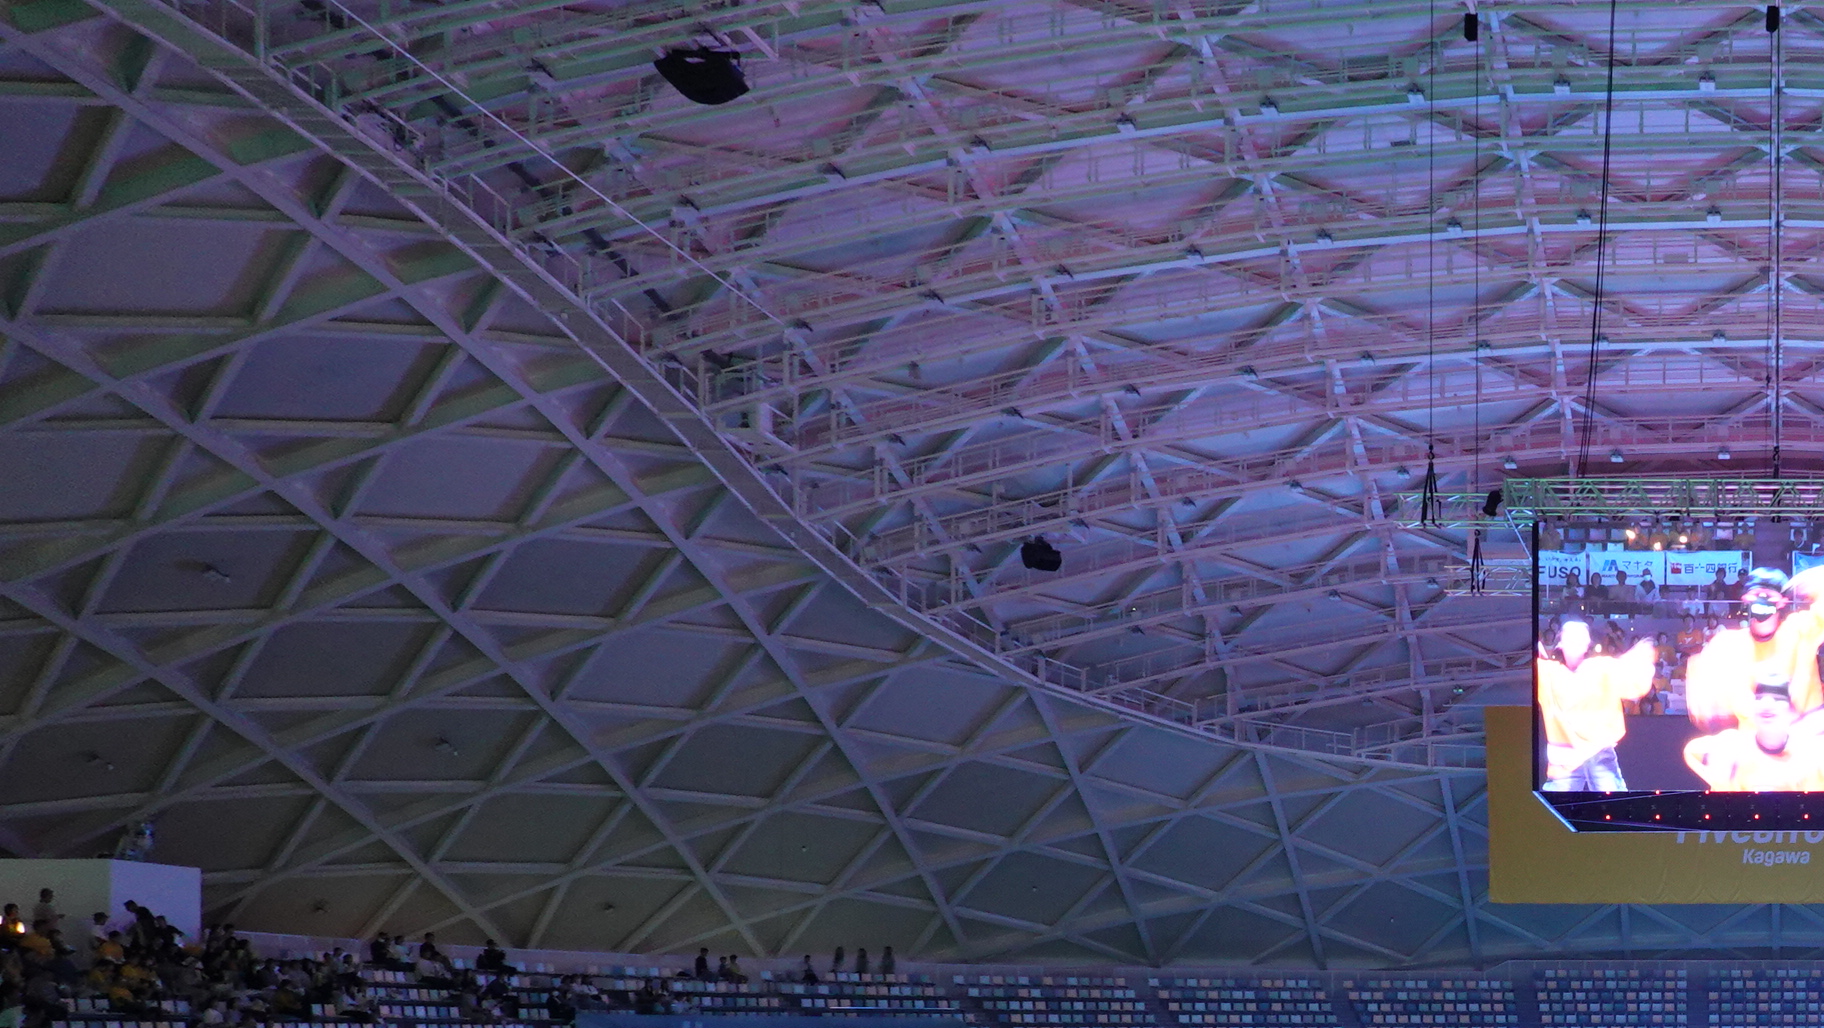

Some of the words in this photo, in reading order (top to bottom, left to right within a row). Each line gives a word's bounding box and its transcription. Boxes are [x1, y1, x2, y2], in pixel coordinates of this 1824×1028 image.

[1621, 560, 1654, 571] マキタ
[1742, 848, 1811, 867] Kagawa
